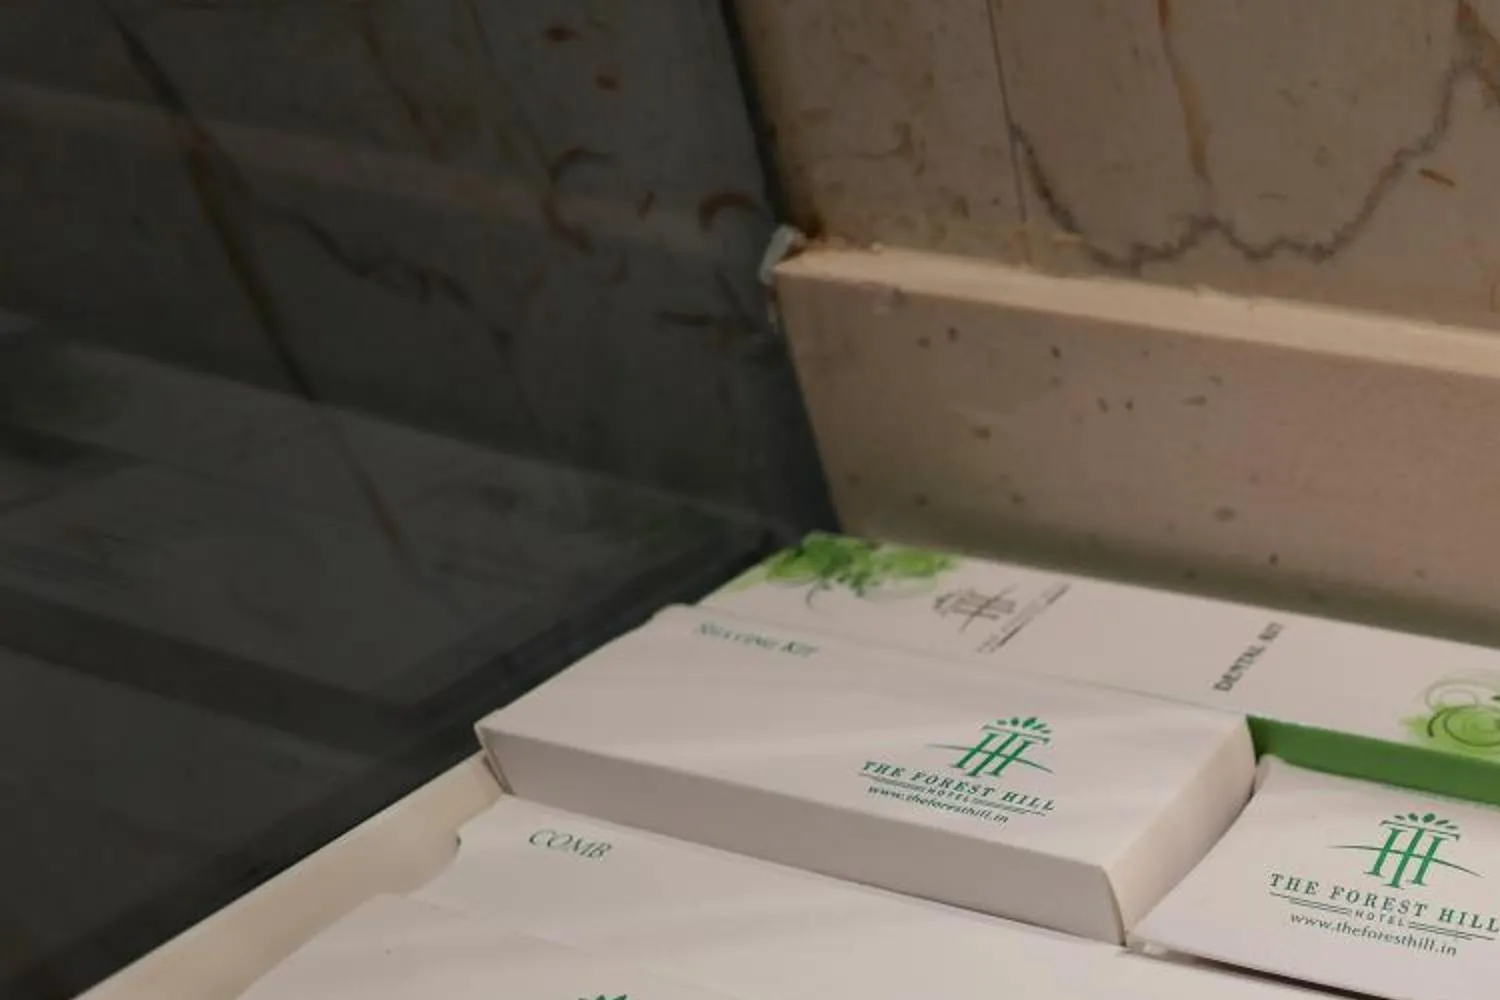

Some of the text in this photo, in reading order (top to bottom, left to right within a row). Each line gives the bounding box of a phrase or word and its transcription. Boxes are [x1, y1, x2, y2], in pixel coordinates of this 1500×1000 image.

[1212, 645, 1268, 692] DENTAL
[862, 761, 1055, 812] THE FOREST HILL
[867, 786, 1009, 825] www.theforesthill.in
[528, 829, 613, 859] COMB
[1269, 872, 1500, 933] THE FOREST HILL
[1354, 910, 1405, 927] HOTEL
[1290, 913, 1457, 957] www.theforesthill.in
